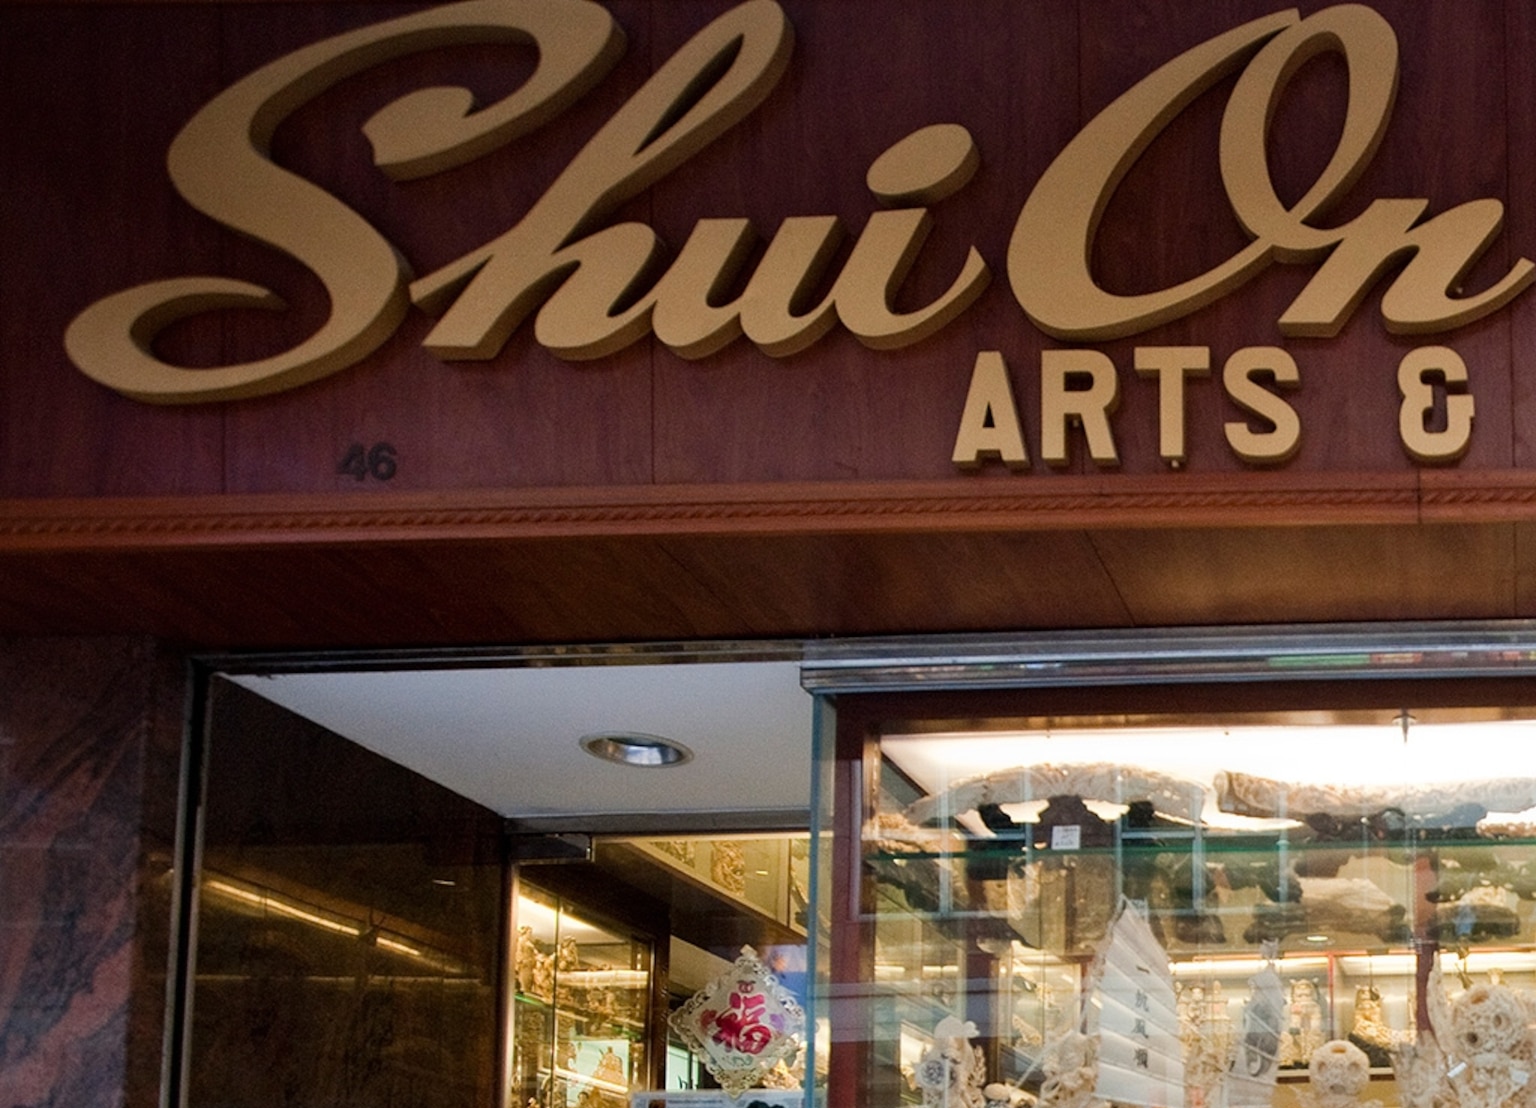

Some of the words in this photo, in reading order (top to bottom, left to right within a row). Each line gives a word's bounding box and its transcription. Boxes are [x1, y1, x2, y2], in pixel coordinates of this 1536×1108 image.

[64, 0, 992, 405] Shui
[1006, 3, 1536, 342] On
[335, 441, 398, 482] 46
[951, 345, 1304, 470] ARTS
[1397, 345, 1476, 465] &
